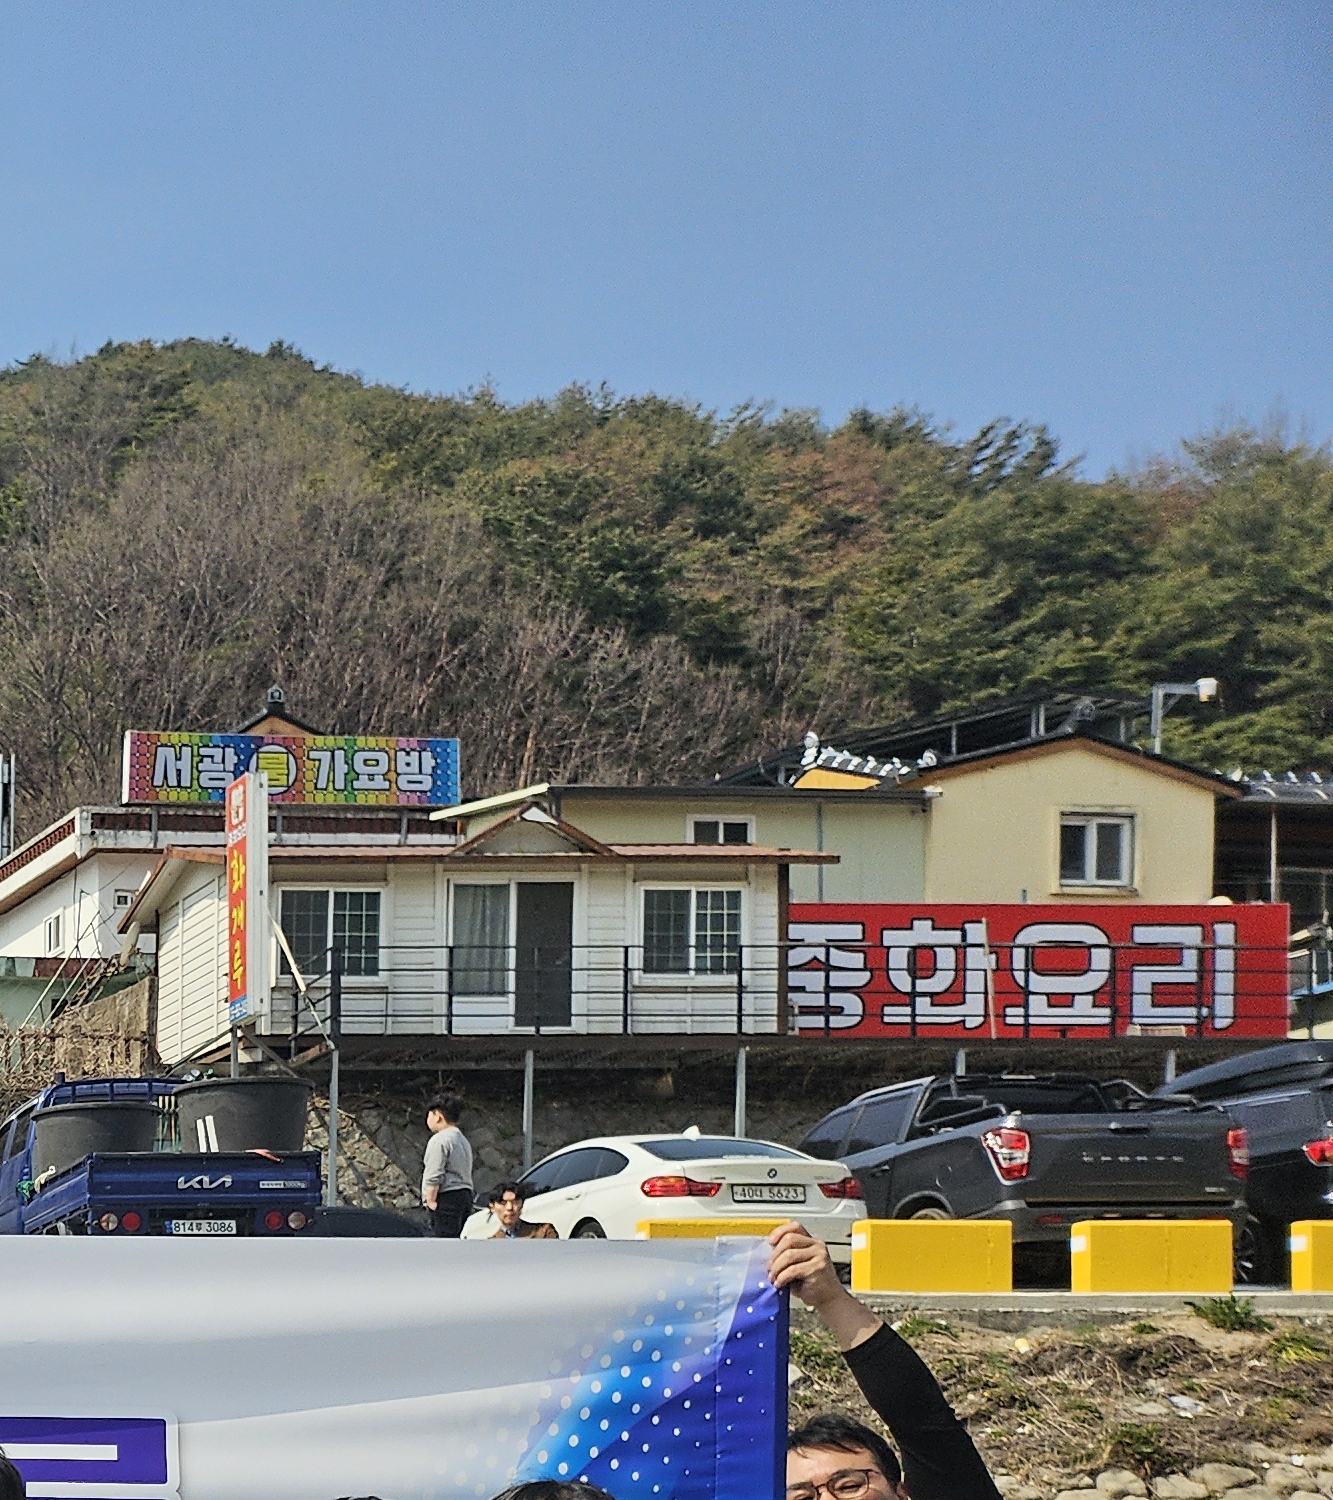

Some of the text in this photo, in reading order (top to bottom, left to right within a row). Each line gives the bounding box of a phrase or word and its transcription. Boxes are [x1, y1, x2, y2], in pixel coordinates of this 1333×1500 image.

[153, 745, 238, 789] 서광
[306, 748, 436, 792] 가요방
[787, 917, 1237, 1030] 중화요리
[205, 1221, 234, 1233] 3086
